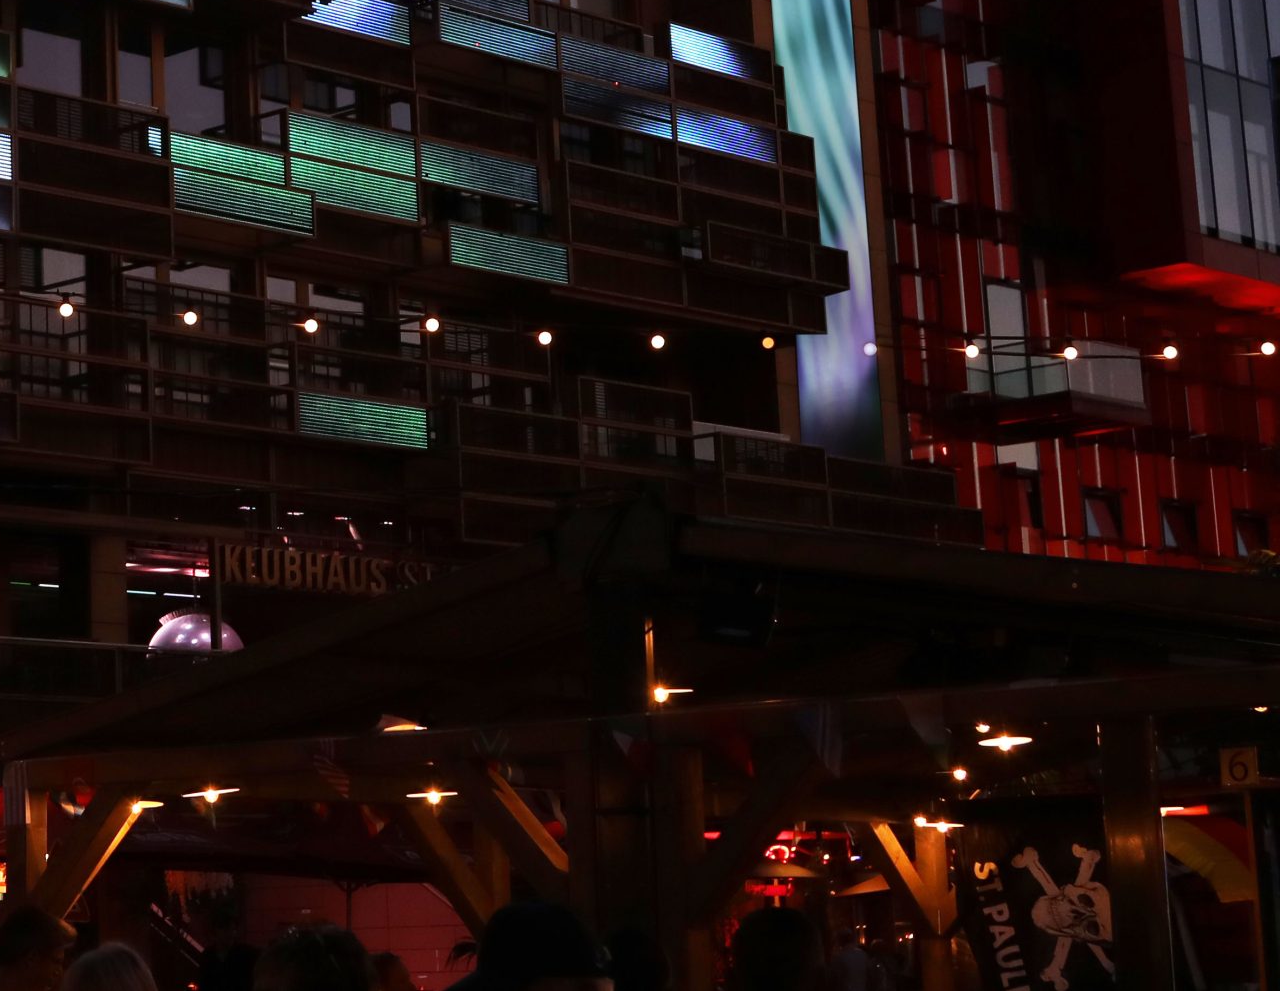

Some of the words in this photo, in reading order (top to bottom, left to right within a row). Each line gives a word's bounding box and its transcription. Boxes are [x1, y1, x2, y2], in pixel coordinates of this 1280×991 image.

[223, 544, 388, 594] KLUBHAUS
[1228, 750, 1249, 782] 6
[973, 860, 1004, 902] ST.
